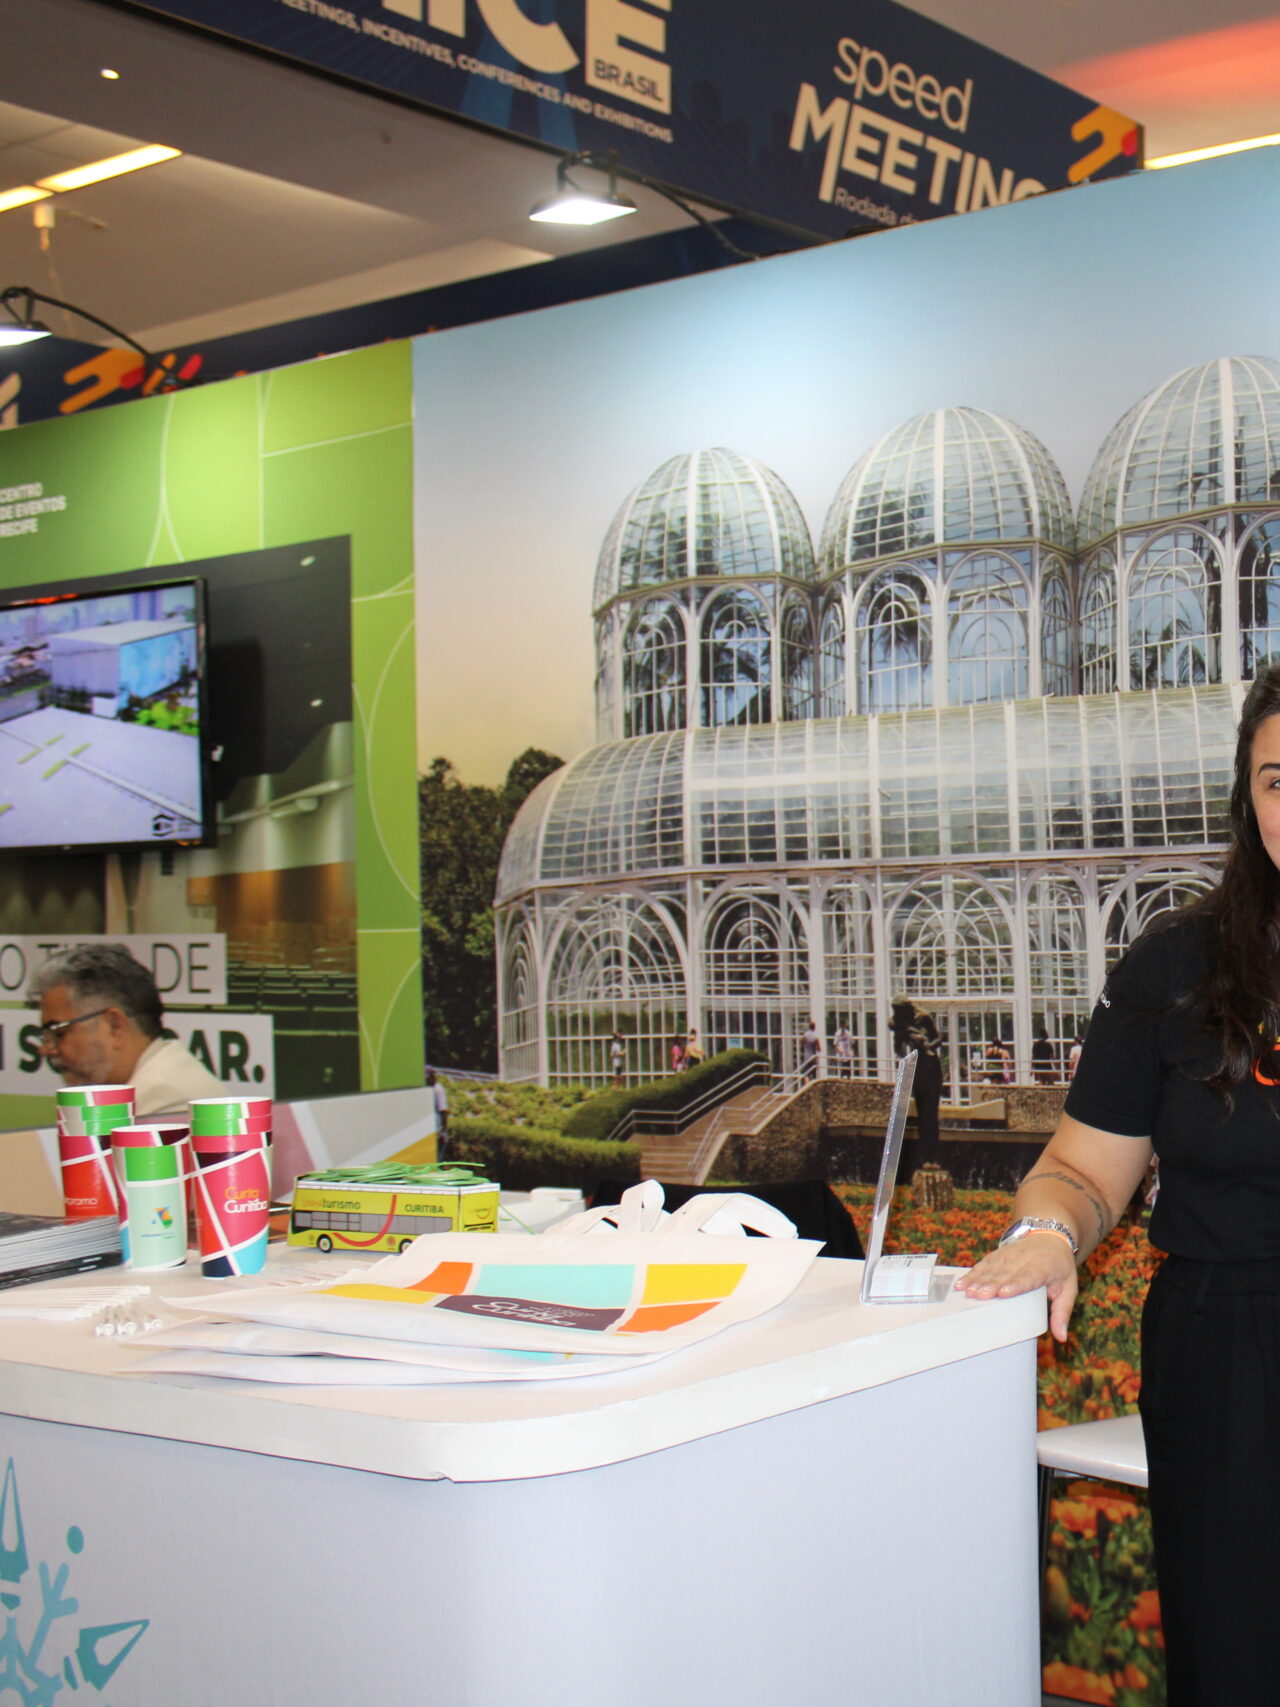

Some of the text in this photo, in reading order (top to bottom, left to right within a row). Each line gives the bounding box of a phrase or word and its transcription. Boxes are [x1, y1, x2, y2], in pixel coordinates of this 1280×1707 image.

[361, 18, 457, 68] INCENTIVES,
[457, 54, 562, 103] CONFERENCES
[562, 92, 593, 114] AND
[593, 103, 674, 143] EXHIBITIONS
[593, 58, 664, 102] BRASIL
[833, 37, 973, 134] speed
[833, 186, 898, 226] Rodada
[153, 943, 211, 994] DE
[224, 1198, 267, 1214] Curitiba
[404, 1203, 444, 1213] CURITIBA
